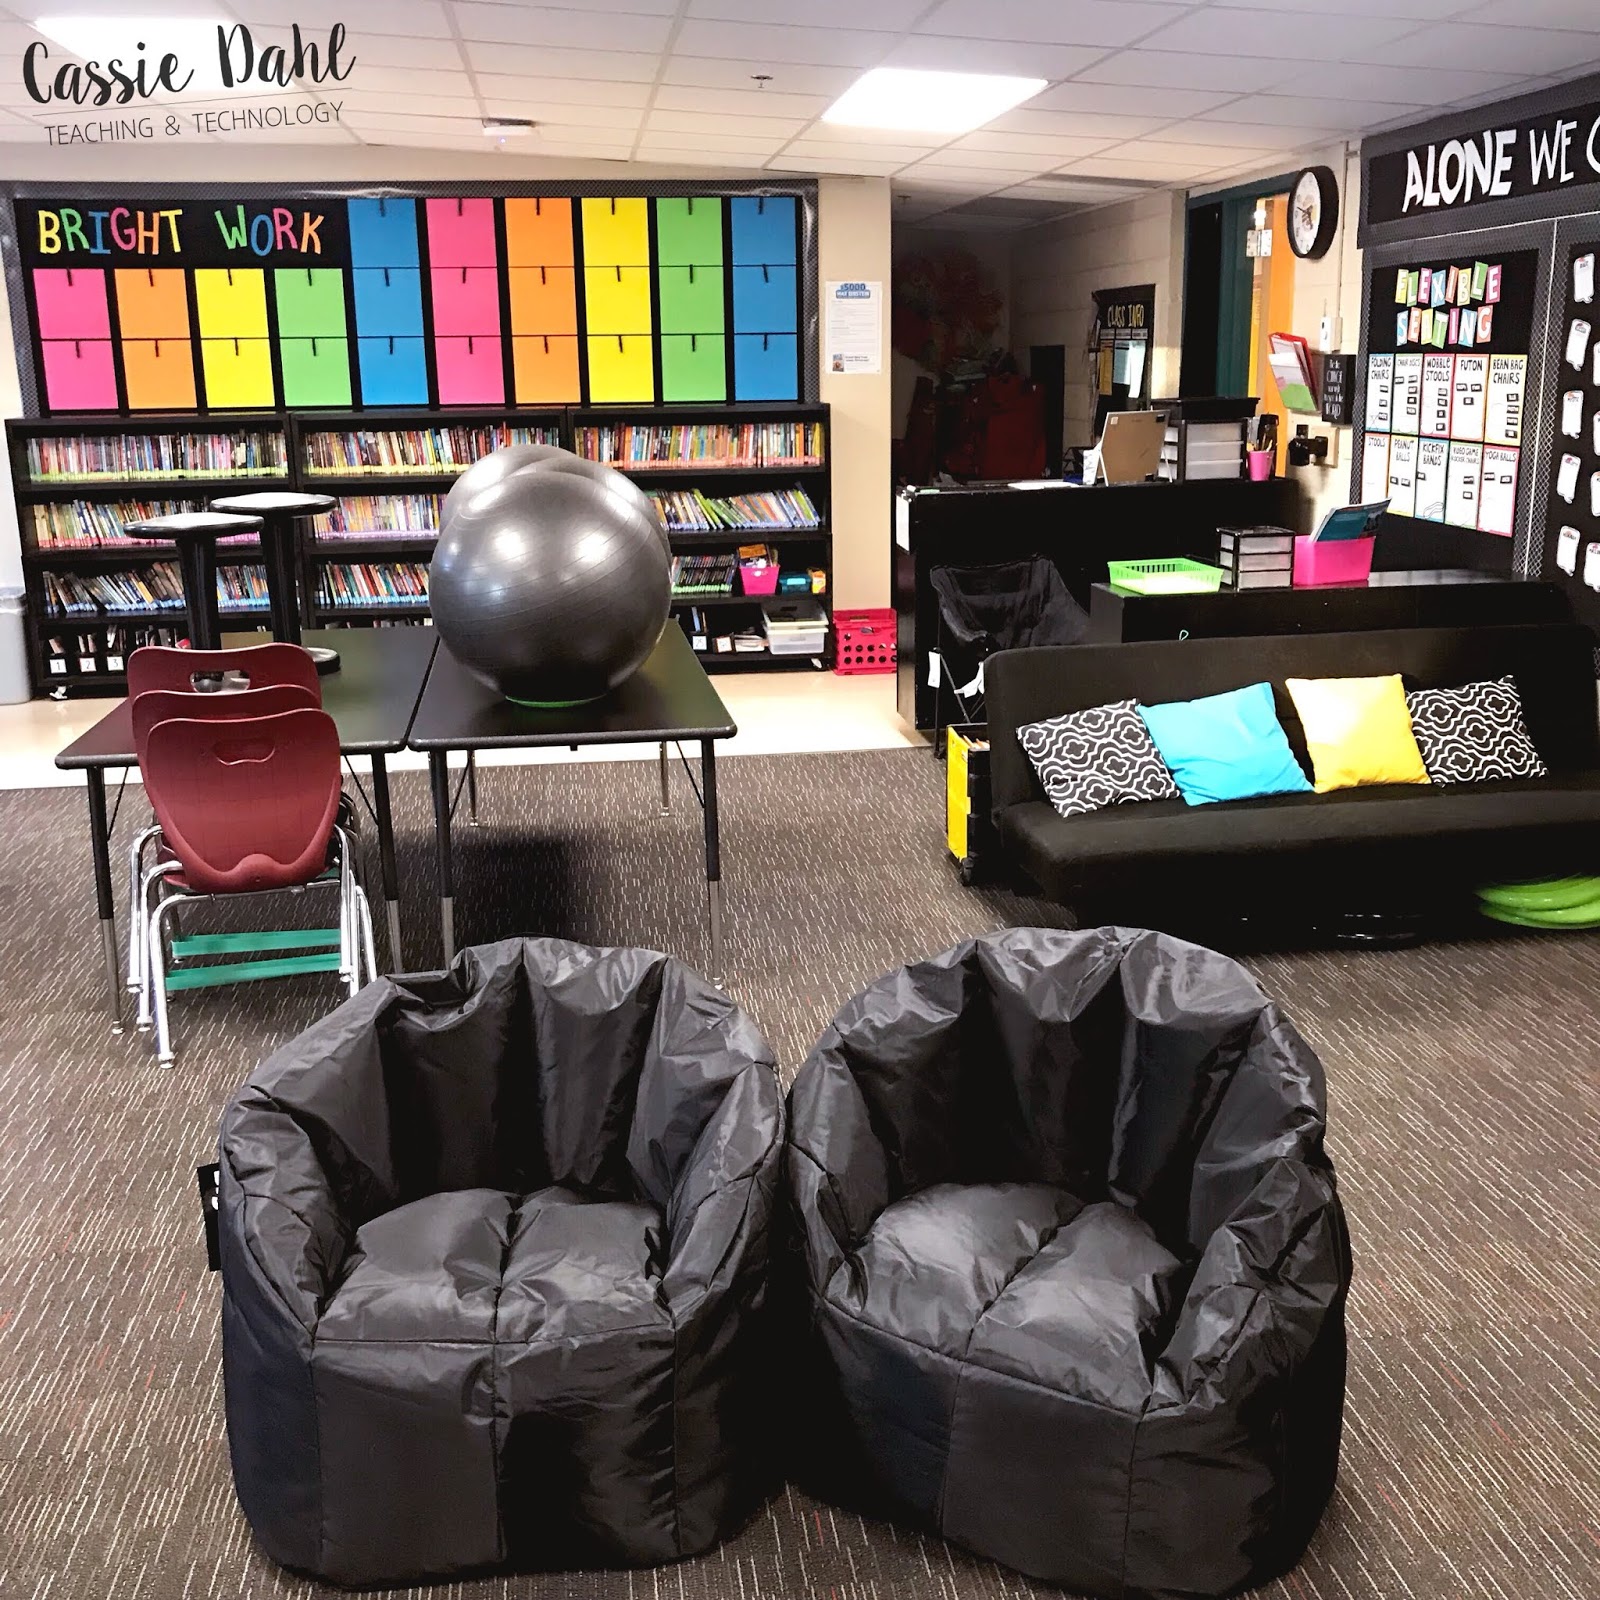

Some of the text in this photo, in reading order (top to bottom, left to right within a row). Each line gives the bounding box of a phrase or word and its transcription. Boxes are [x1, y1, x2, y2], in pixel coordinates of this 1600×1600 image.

[1401, 128, 1517, 213] ALONE
[1529, 119, 1578, 186] WE
[38, 204, 325, 257] BRIGHT WORK
[1395, 262, 1501, 307] FLEXIBLE
[1107, 304, 1144, 328] CLASS INFO
[1396, 305, 1493, 349] SEATING
[1371, 357, 1391, 369] FOLDING
[1460, 359, 1483, 371] FUTON
[1492, 358, 1523, 371] BEAN BAG
[1371, 369, 1389, 380] CHAIRS
[1426, 370, 1450, 382] STOOLS
[1493, 372, 1520, 384] CHAIRS
[1368, 437, 1385, 447] STOOLS
[1394, 439, 1414, 450] PEANUT
[1423, 454, 1442, 466] BANDS
[1485, 450, 1516, 462] YOGA BALLS
[113, 658, 119, 668] 3
